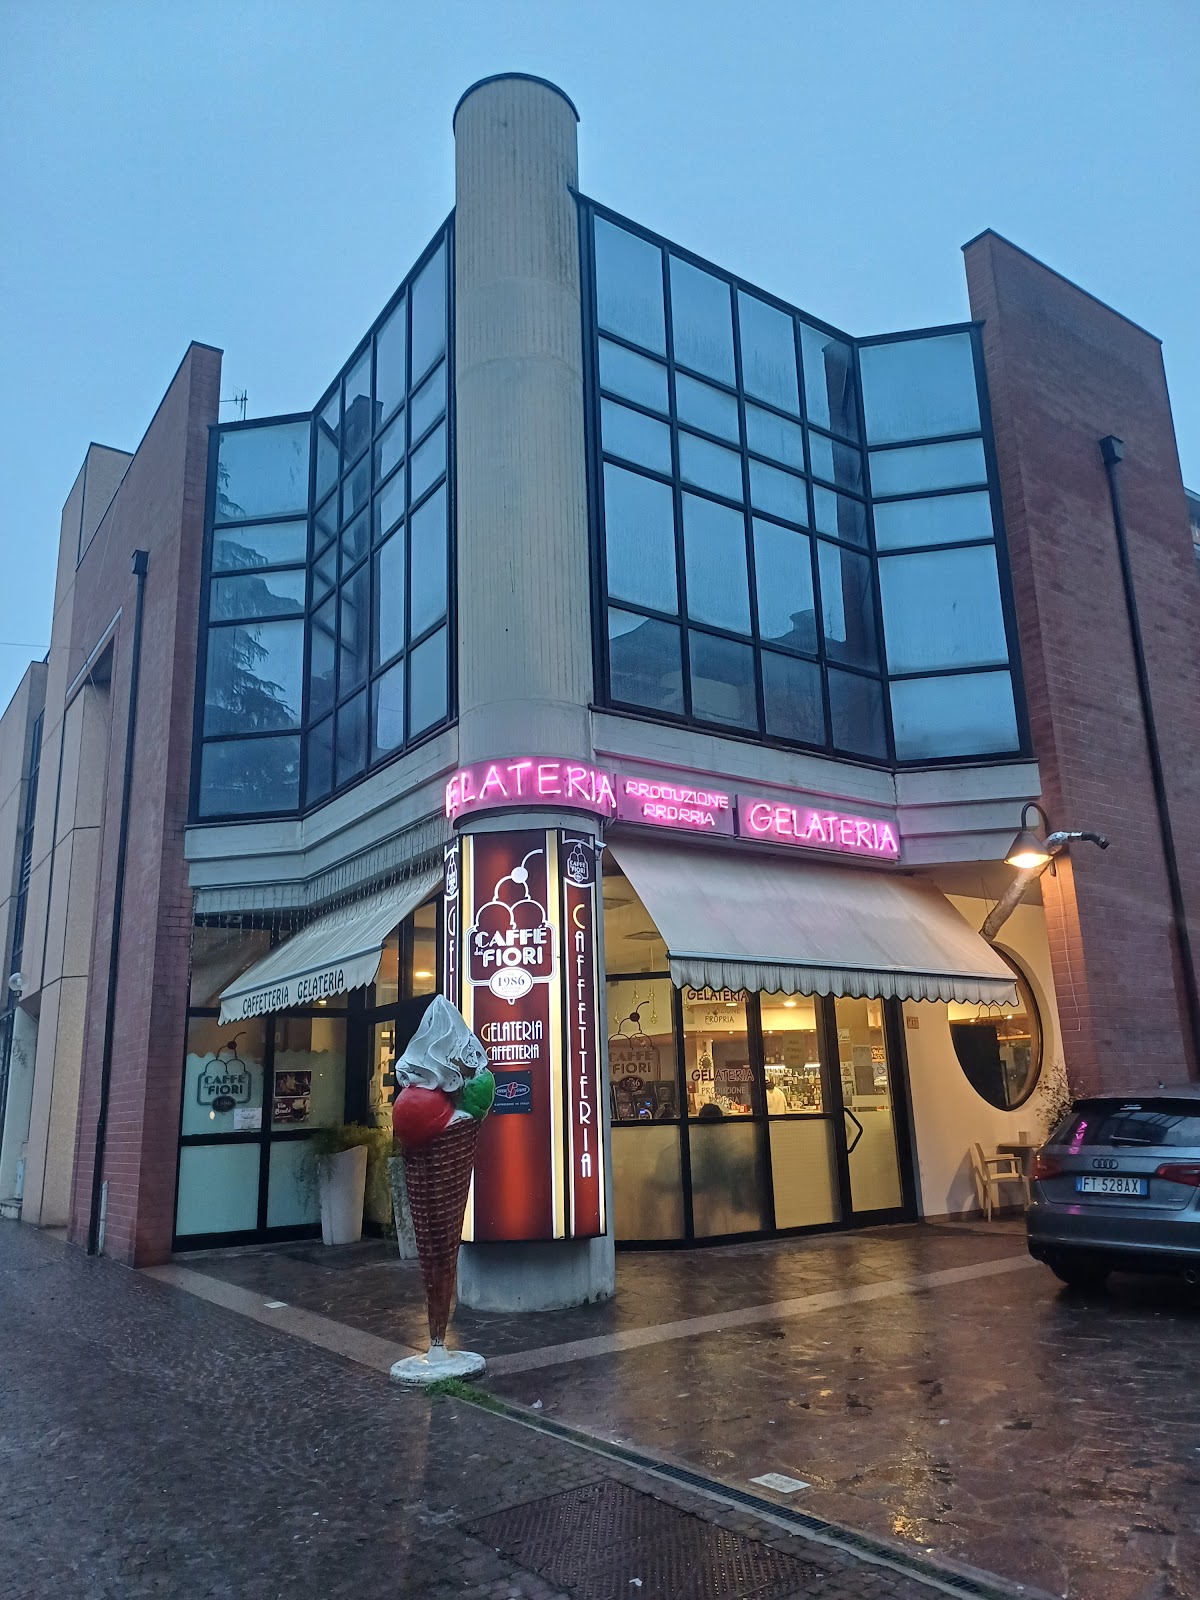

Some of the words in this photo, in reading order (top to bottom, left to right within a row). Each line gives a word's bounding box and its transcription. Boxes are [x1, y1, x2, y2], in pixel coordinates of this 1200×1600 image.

[750, 803, 898, 852] GELATERIA
[482, 946, 544, 968] FIORI
[497, 974, 526, 987] 1986
[242, 985, 290, 1016] CAFFETTERIA
[297, 969, 344, 1000] GELATERIA
[480, 1020, 543, 1043] GELATERIA
[572, 903, 592, 1178] CAFFETTERIA
[485, 1044, 540, 1061] CAFFETTERIA
[612, 1062, 652, 1074] FIORI
[691, 1068, 755, 1082] GELATERIA
[207, 1084, 243, 1095] FIORI
[701, 1086, 747, 1095] PRODUZIONE
[1083, 1178, 1096, 1190] FT
[1101, 1180, 1139, 1193] 528AX
